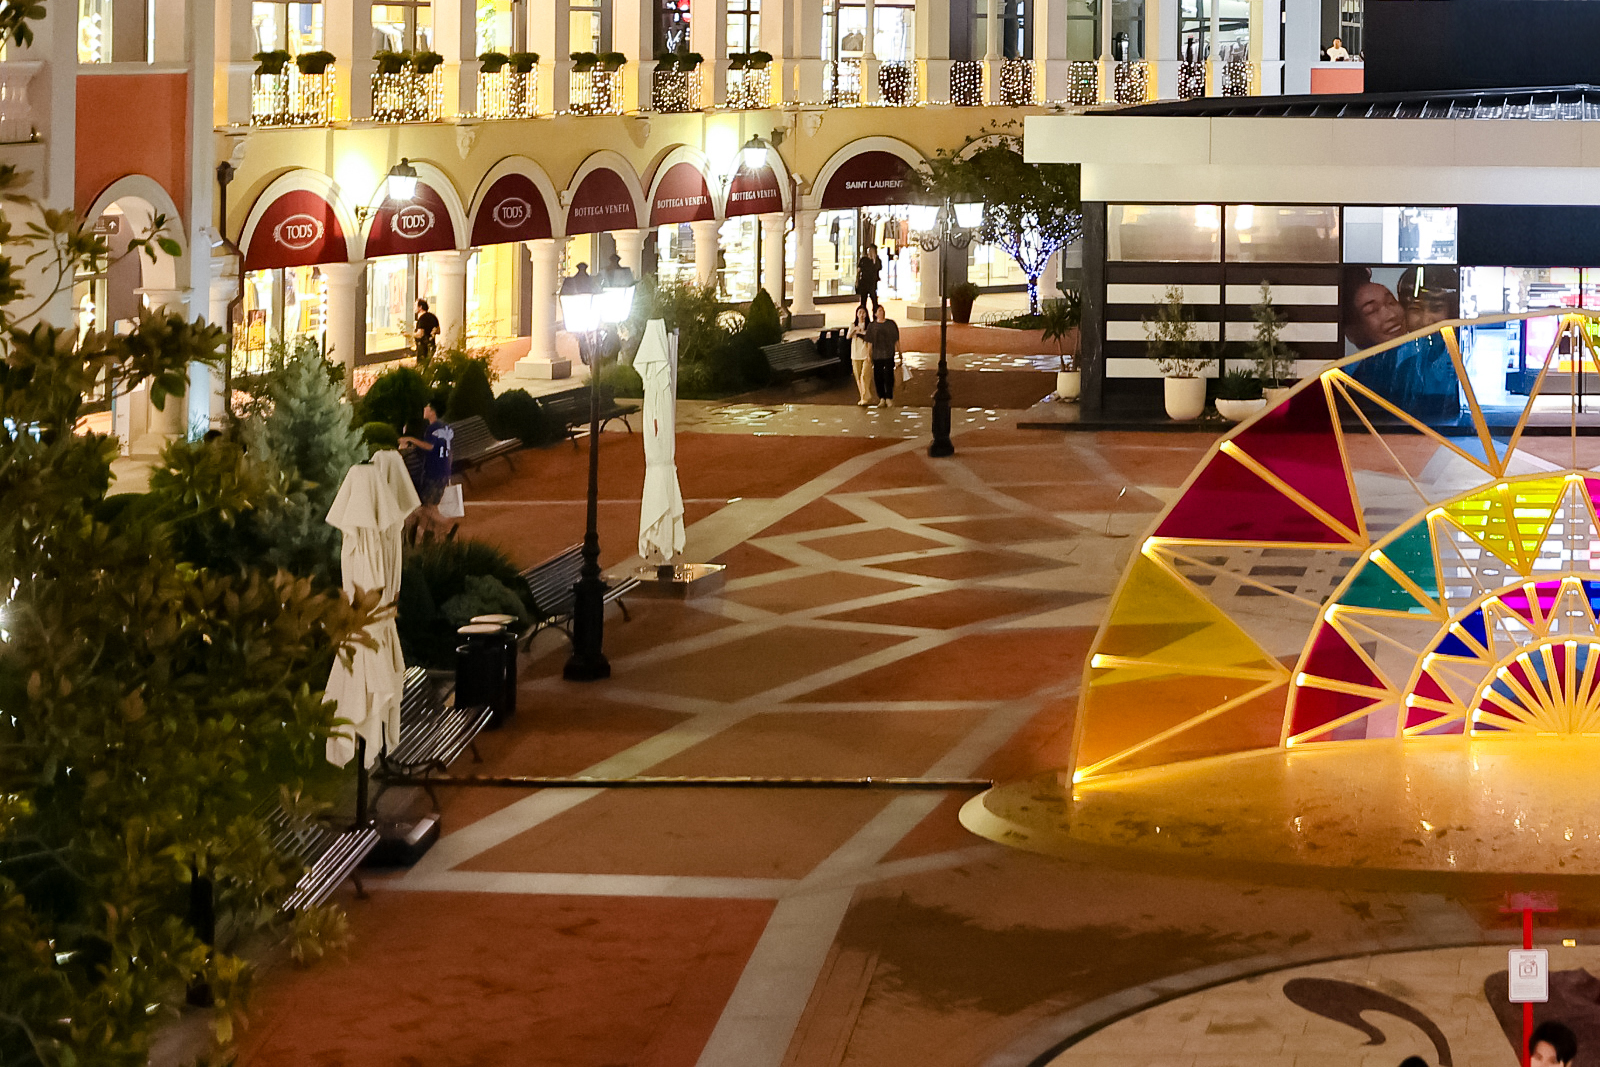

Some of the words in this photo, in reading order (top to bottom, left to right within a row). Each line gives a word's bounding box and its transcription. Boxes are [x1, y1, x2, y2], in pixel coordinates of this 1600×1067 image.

[845, 180, 868, 189] SAINT
[869, 180, 903, 189] LAURENT
[657, 197, 684, 209] BOTTEGA
[684, 195, 708, 207] VENETA
[731, 190, 756, 202] BOTTEGA
[756, 189, 777, 200] VENETA
[502, 206, 523, 219] TOD'S
[574, 206, 603, 218] BOTTEGA
[604, 203, 630, 215] VENETA
[401, 214, 425, 230] TOD'S
[285, 224, 313, 240] TOD'S
